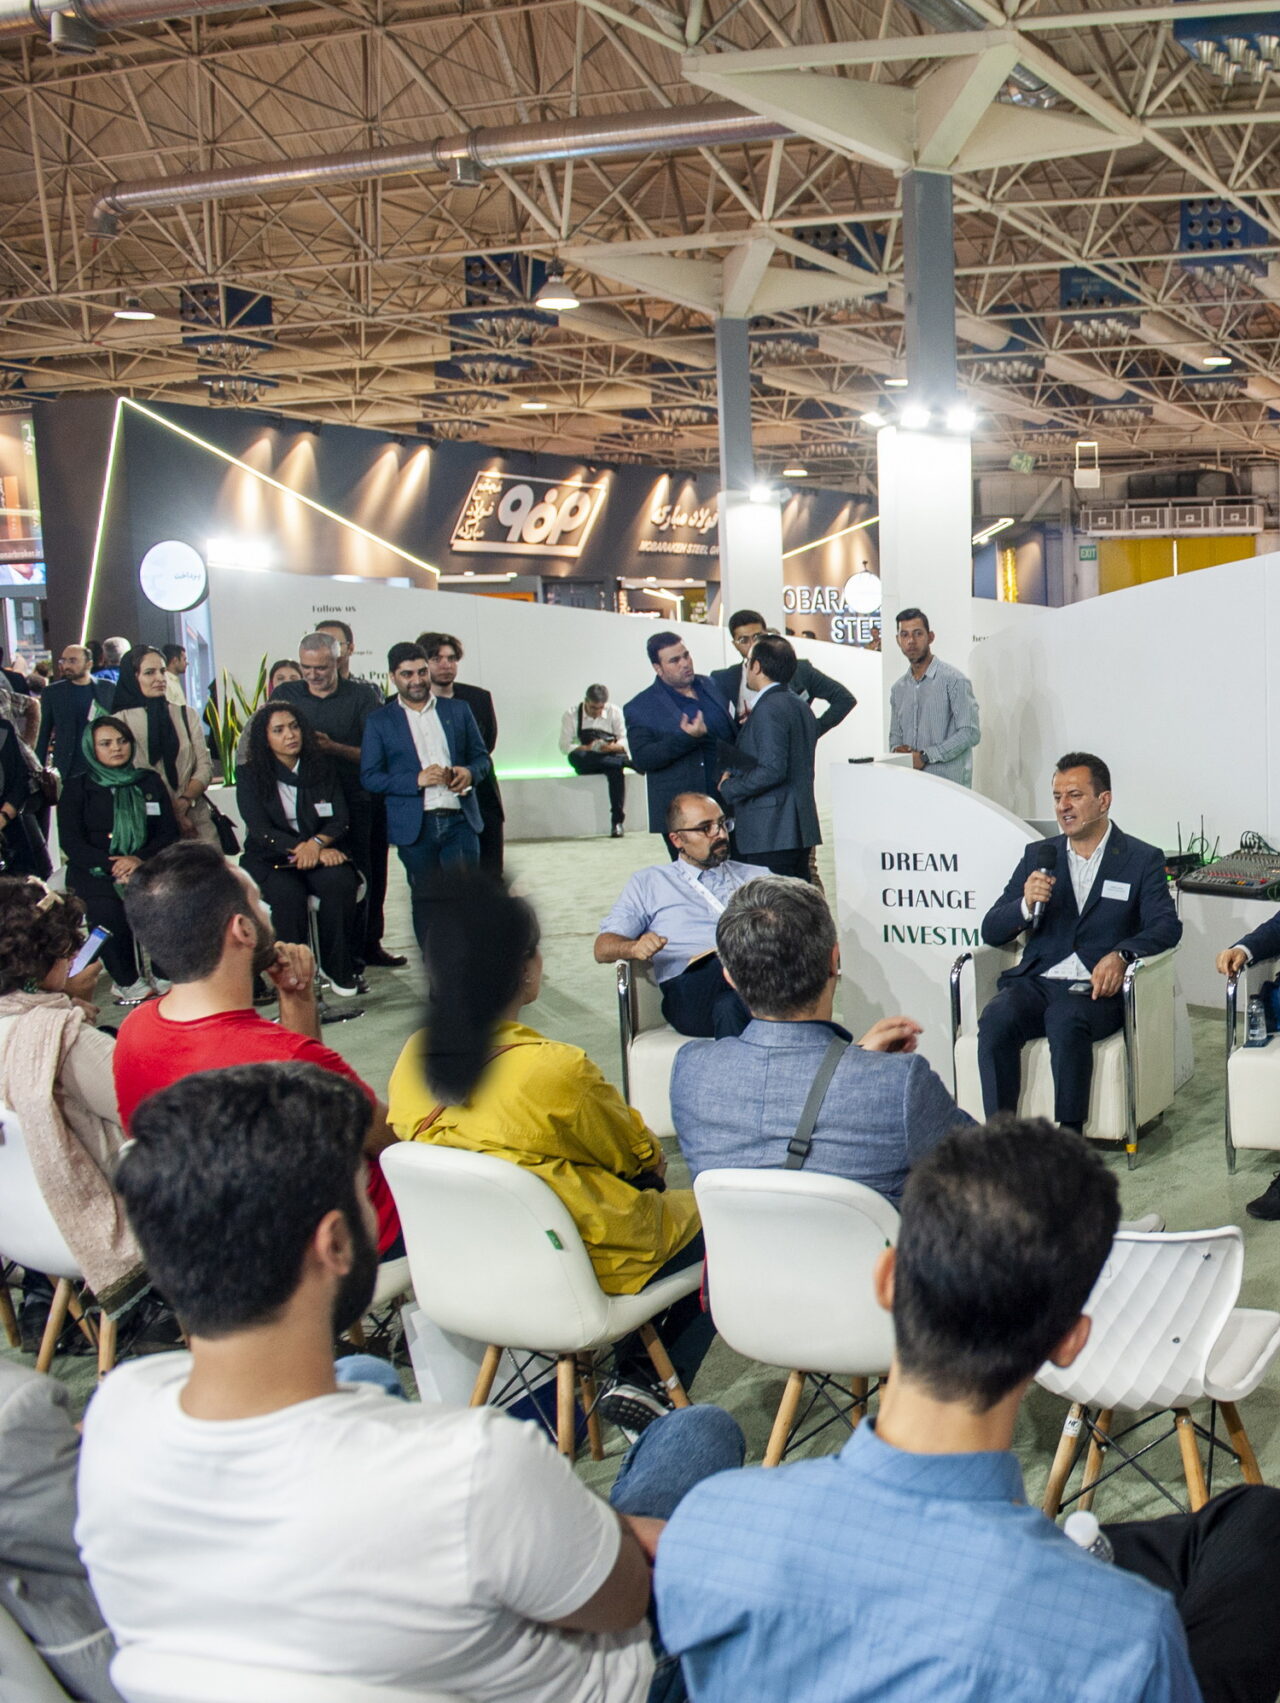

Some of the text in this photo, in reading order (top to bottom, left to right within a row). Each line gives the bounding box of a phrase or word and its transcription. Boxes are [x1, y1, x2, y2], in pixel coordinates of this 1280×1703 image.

[312, 605, 342, 613] Follow
[881, 851, 958, 872] DREAM
[882, 888, 977, 909] CHANGE
[883, 924, 979, 946] INVESTM
